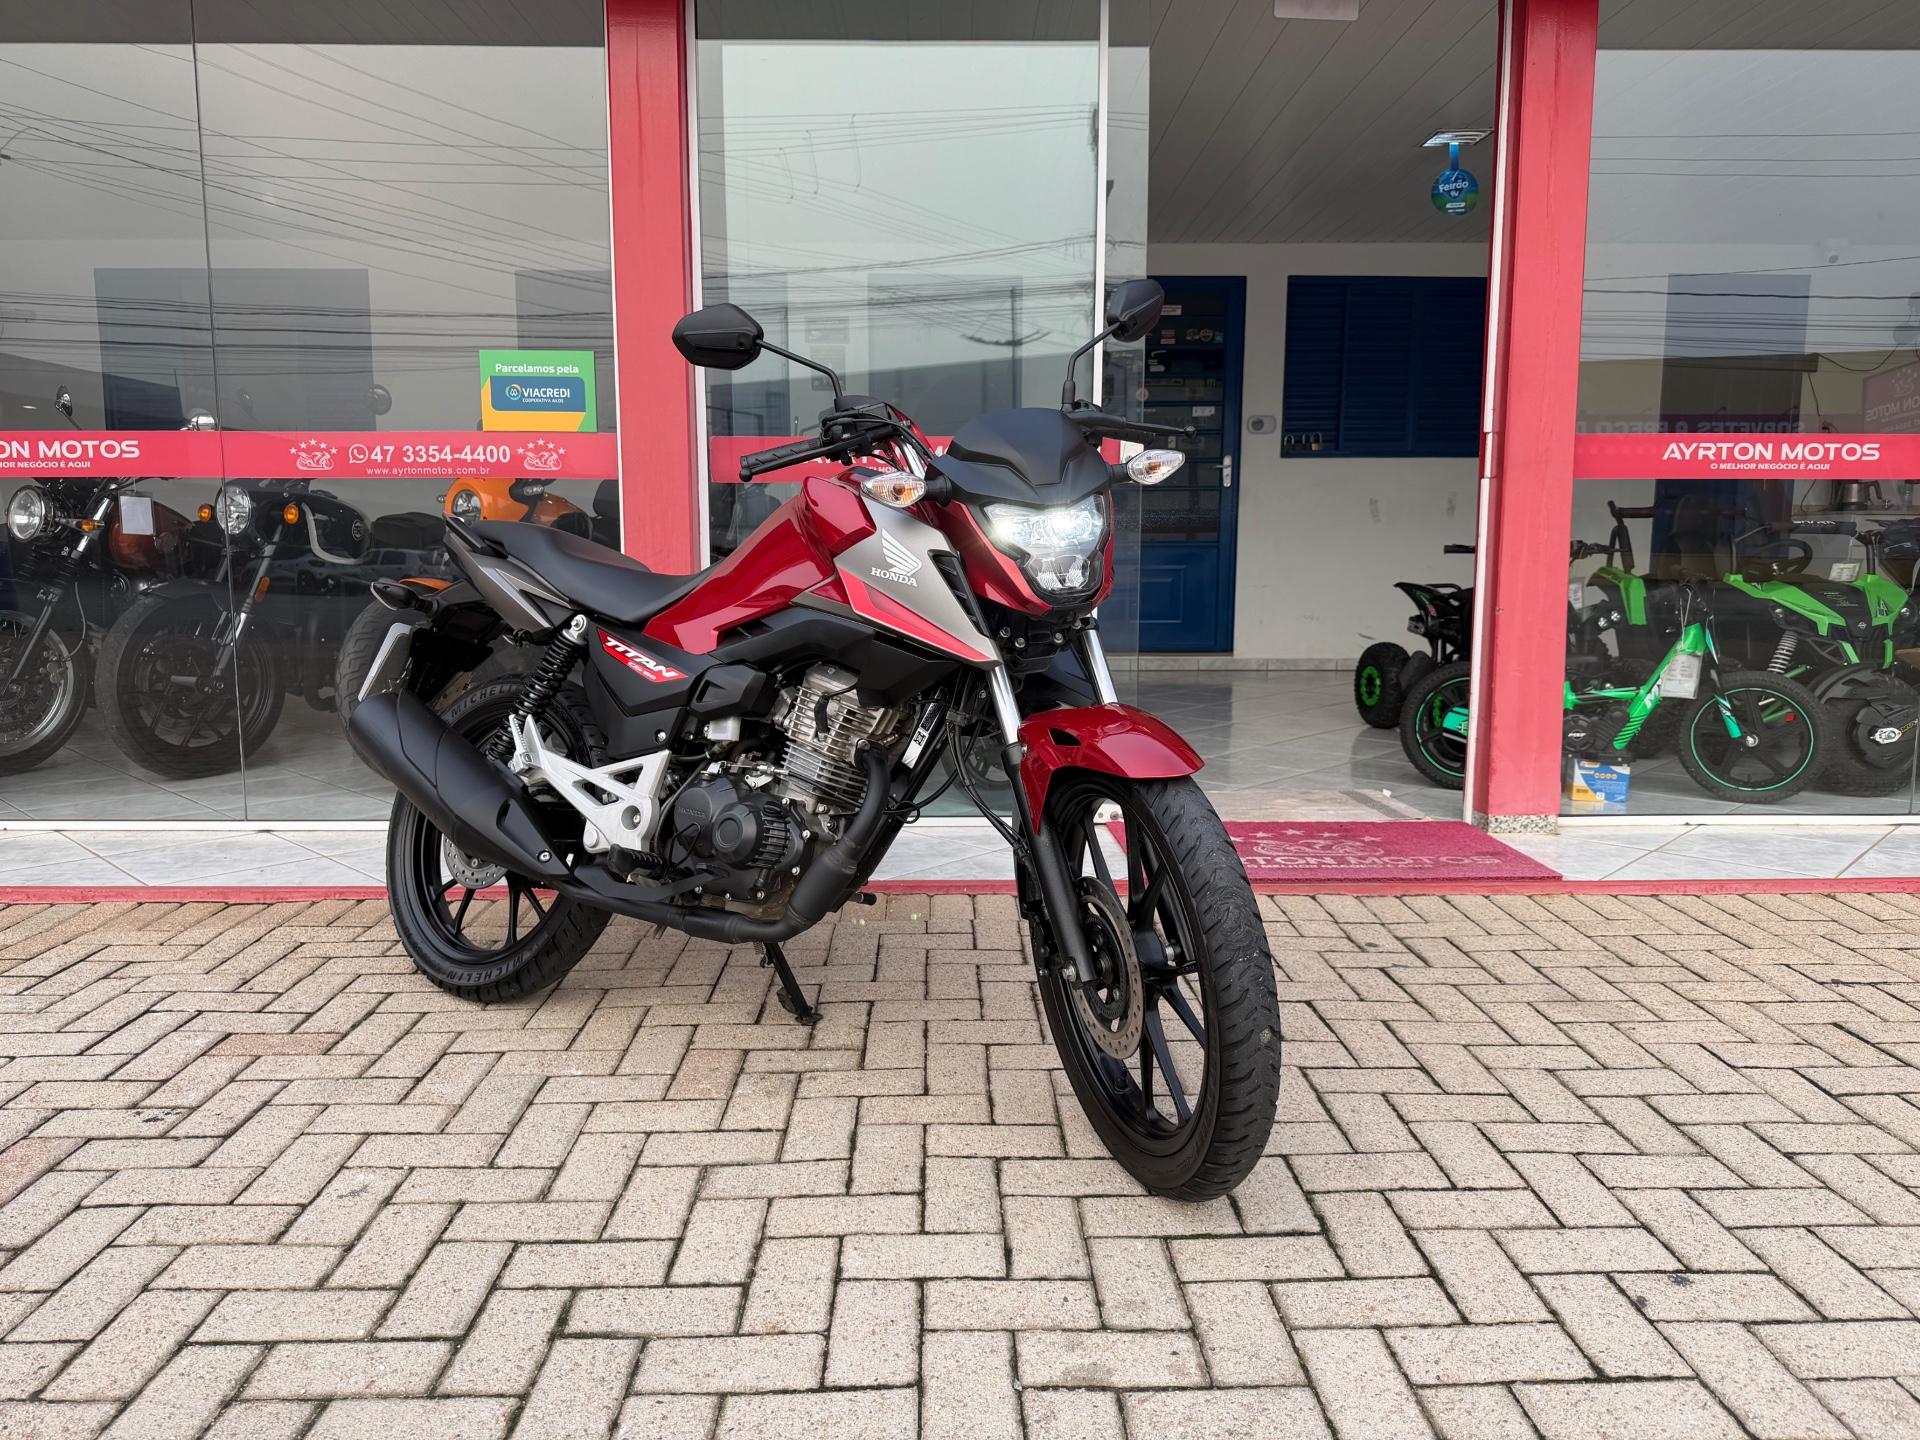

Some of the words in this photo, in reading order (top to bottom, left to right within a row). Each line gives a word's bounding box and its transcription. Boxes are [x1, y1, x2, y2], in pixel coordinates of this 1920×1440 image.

[495, 363, 555, 373] Parcelamos
[556, 365, 579, 375] pela
[522, 387, 570, 398] VIACREDI
[38, 440, 140, 458] MOTOS
[370, 445, 395, 463] 47
[402, 445, 511, 463] 3354-4400
[1662, 442, 1774, 461] AYRTON
[1781, 442, 1880, 461] MOTOS
[17, 459, 59, 468] NEGÓCIO
[366, 466, 490, 475] www.ayrtonmotos.com.br
[1758, 461, 1798, 470] NEGÓCIO
[1799, 461, 1806, 470] É
[870, 566, 918, 587] HONDA
[605, 636, 679, 678] TITAN
[451, 682, 521, 718] MICHELI
